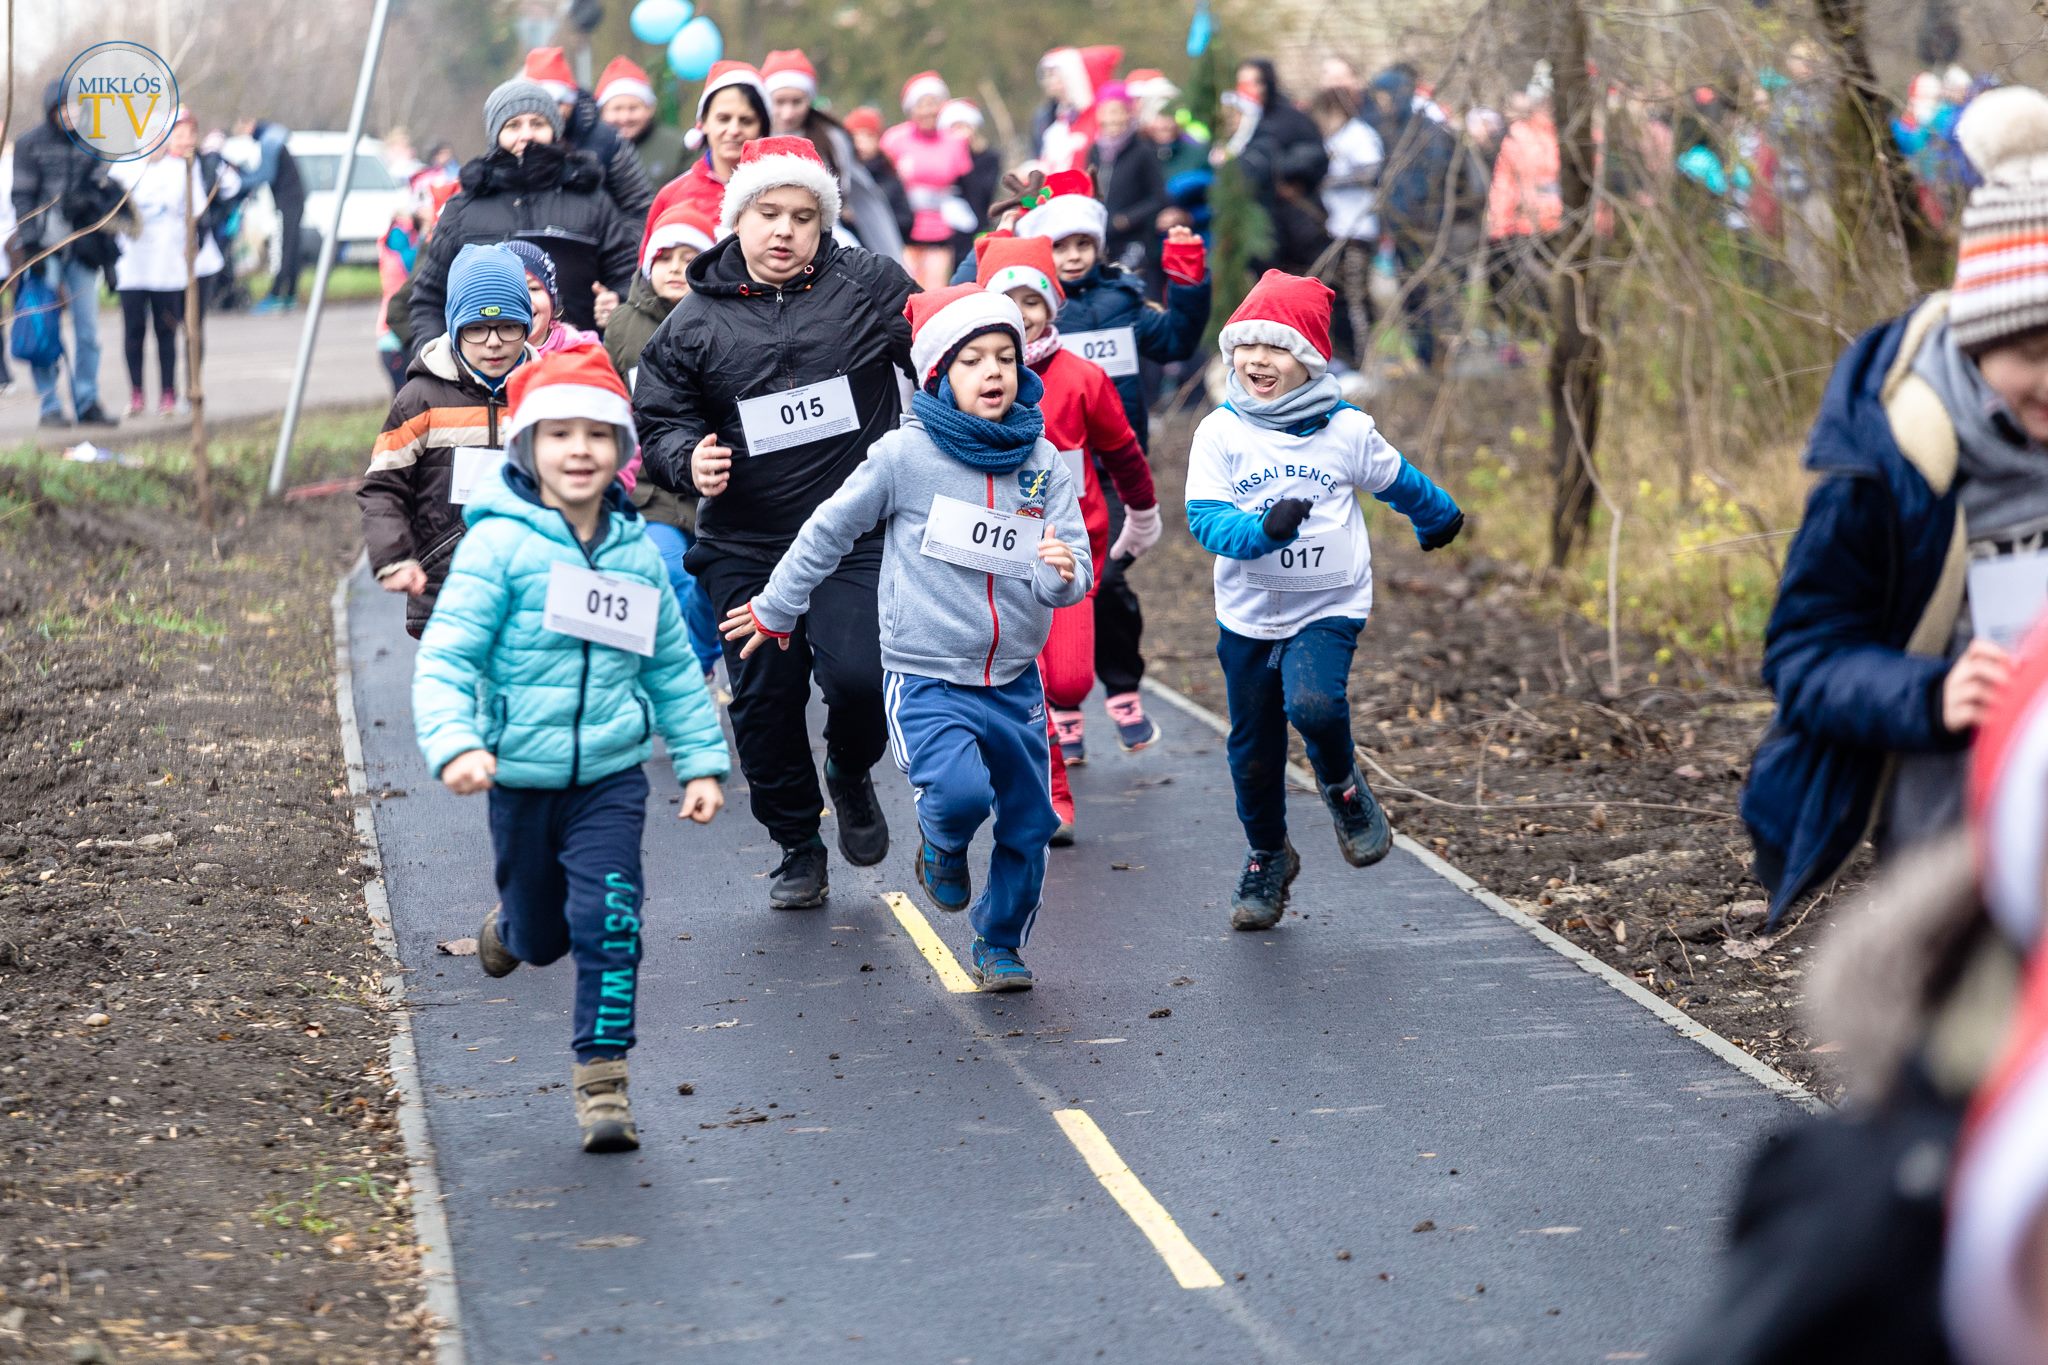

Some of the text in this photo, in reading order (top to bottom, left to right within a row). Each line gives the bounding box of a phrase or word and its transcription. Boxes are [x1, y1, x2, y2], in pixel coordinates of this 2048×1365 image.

[1084, 340, 1118, 360] 023
[780, 396, 825, 425] 015
[1233, 464, 1338, 496] IRSAI BENCE
[972, 521, 1018, 552] 016
[1280, 546, 1325, 569] 017
[587, 590, 629, 621] 013
[602, 872, 640, 955] JUST
